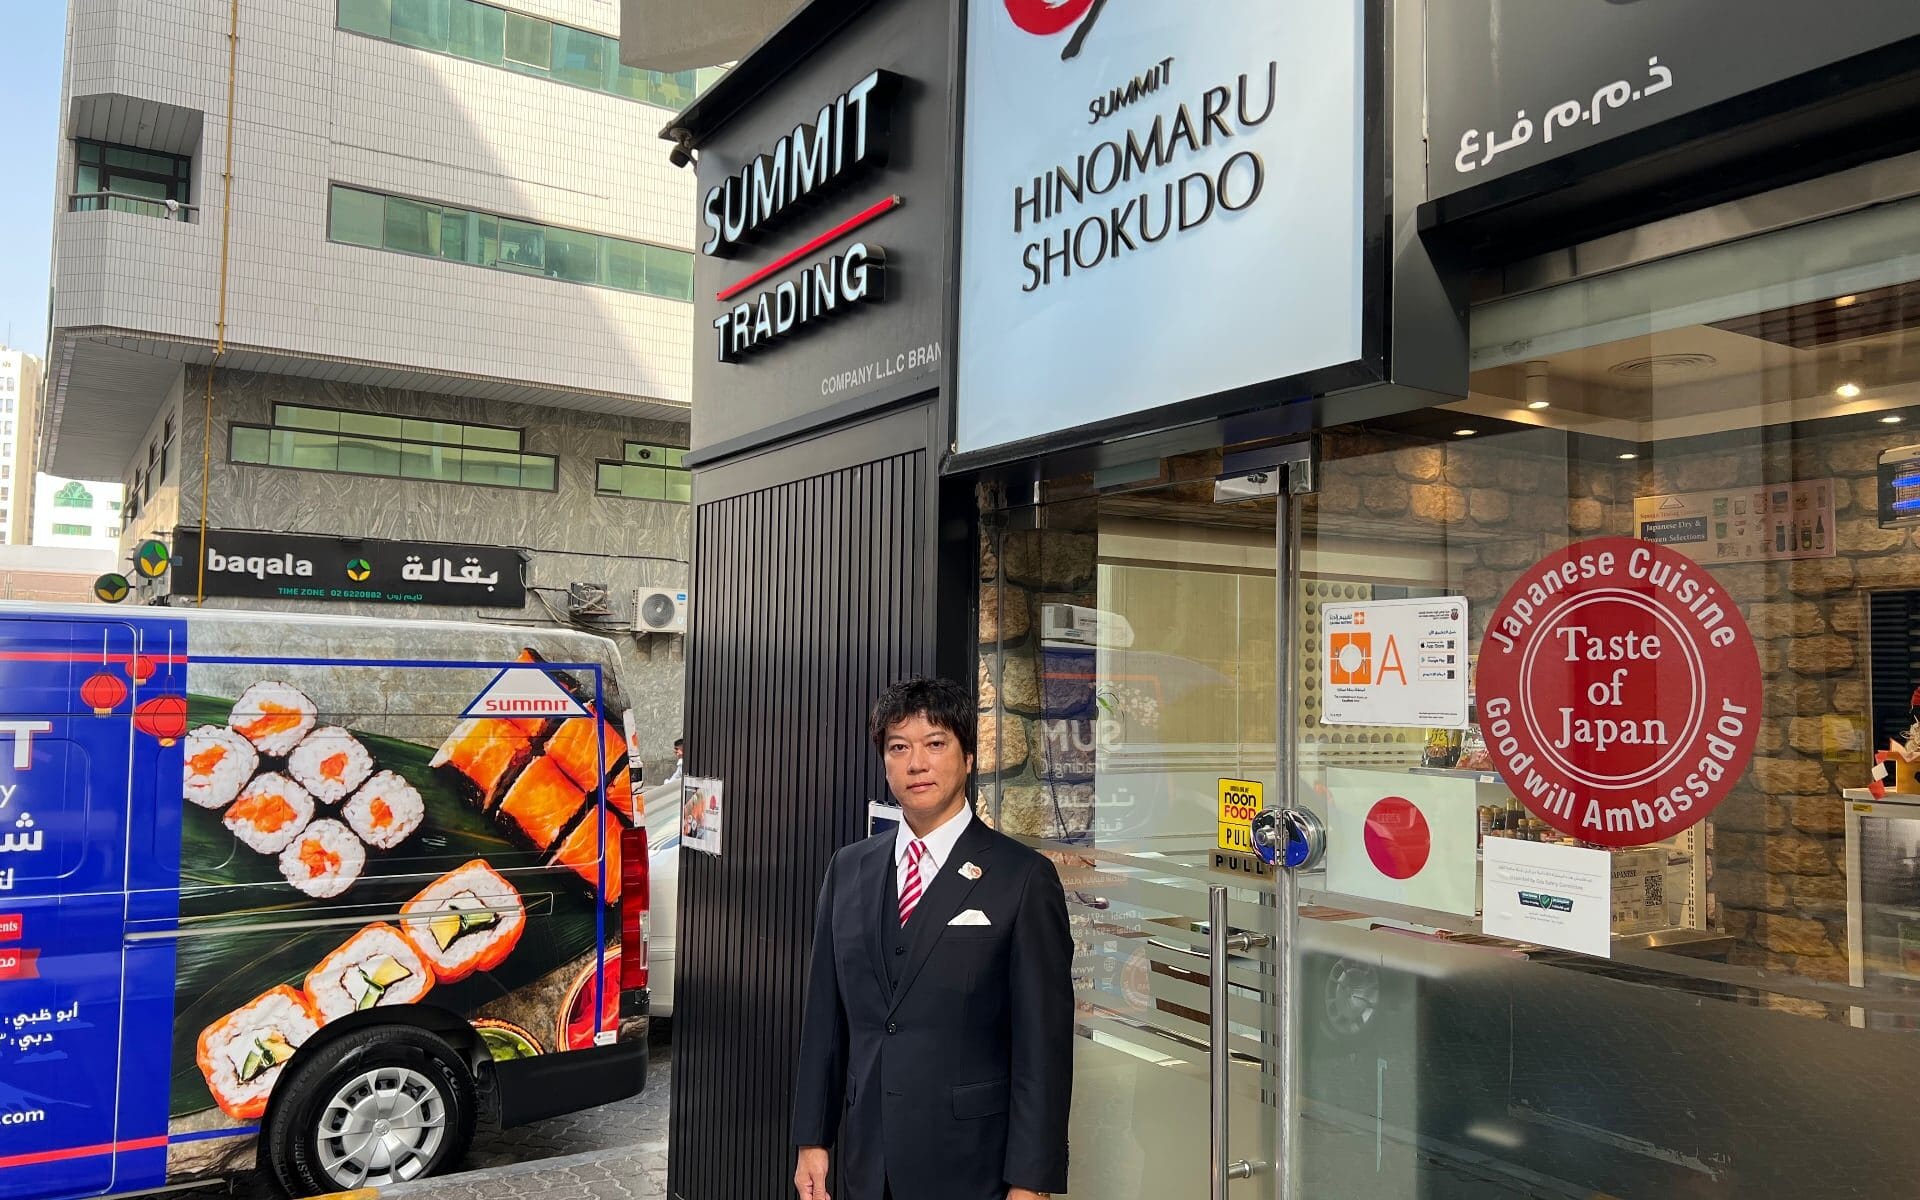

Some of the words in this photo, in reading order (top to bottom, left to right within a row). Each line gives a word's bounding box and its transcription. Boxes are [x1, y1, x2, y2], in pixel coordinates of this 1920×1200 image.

[1088, 56, 1175, 125] SUMMIT
[1543, 56, 1673, 144] ذ.م.م
[1013, 61, 1277, 232] HINOMARU
[1455, 110, 1534, 172] فرع
[703, 71, 881, 256] SUMMIT
[1022, 151, 1265, 292] SHOKUDO
[713, 243, 872, 361] TRADING
[821, 364, 874, 396] COMPANY
[876, 354, 905, 379] L.L.C
[1646, 522, 1677, 532] Japanese
[1678, 521, 1692, 530] Dry
[1669, 533, 1705, 542] Selections
[208, 548, 313, 580] baqala
[401, 555, 498, 593] بقالة
[278, 587, 299, 596] TIME
[300, 588, 325, 596] ZONE
[330, 589, 342, 598] 02
[1491, 552, 1615, 655] Japanese
[1628, 546, 1736, 648] Cuisine
[1376, 634, 1408, 686] A
[1556, 626, 1661, 662] Taste
[485, 699, 568, 712] SUMMIT
[1587, 668, 1627, 706] of
[1555, 707, 1668, 752] Japan
[1486, 697, 1575, 820] Goodwill
[1581, 697, 1748, 833] Ambassador
[1224, 792, 1257, 807] noon
[1224, 805, 1257, 821] FOOD
[1227, 828, 1253, 848] PUL
[1216, 855, 1264, 875] PULL
[13, 1008, 51, 1030] ظبي
[56, 1001, 79, 1022] أبو
[18, 1032, 53, 1051] دبي
